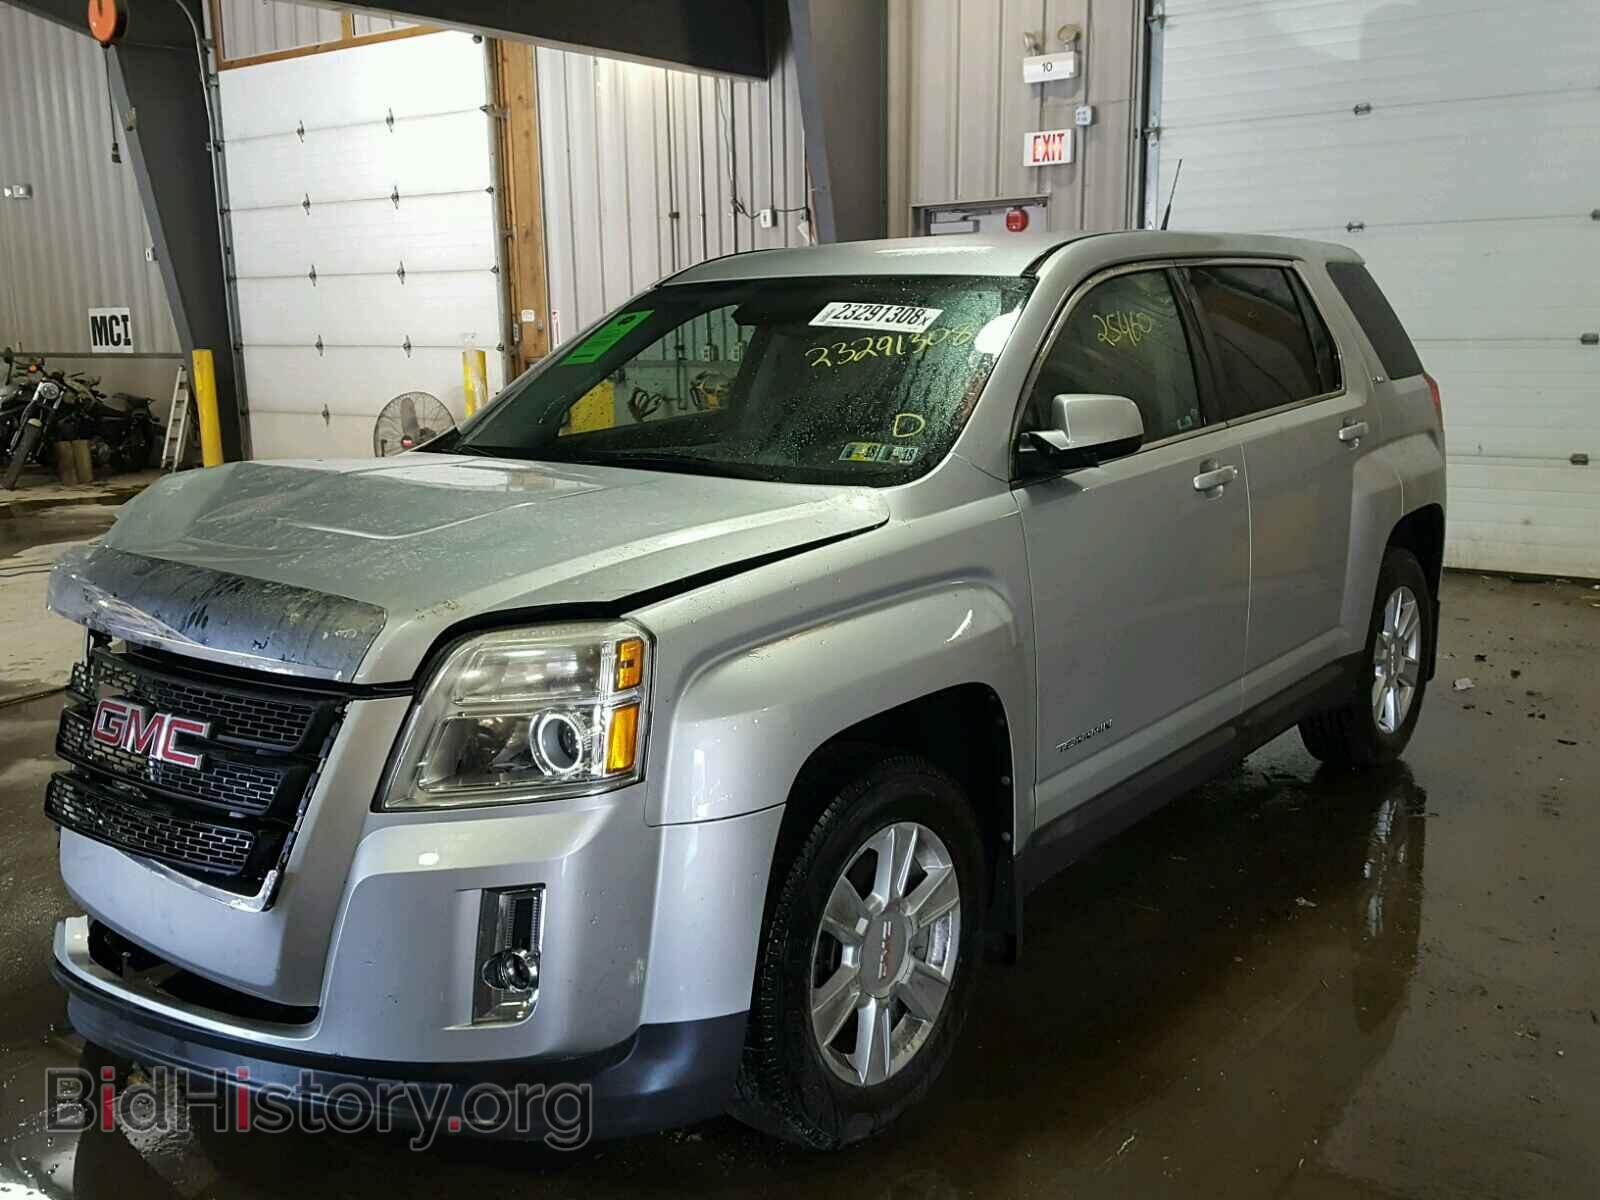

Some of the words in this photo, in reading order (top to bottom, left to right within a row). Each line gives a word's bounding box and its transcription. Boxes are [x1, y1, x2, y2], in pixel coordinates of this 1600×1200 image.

[1042, 62, 1053, 73] 10
[1032, 132, 1065, 163] EXIT
[832, 302, 926, 326] 23291308
[90, 314, 132, 347] MCI
[892, 412, 927, 438] D
[91, 698, 211, 771] GMC
